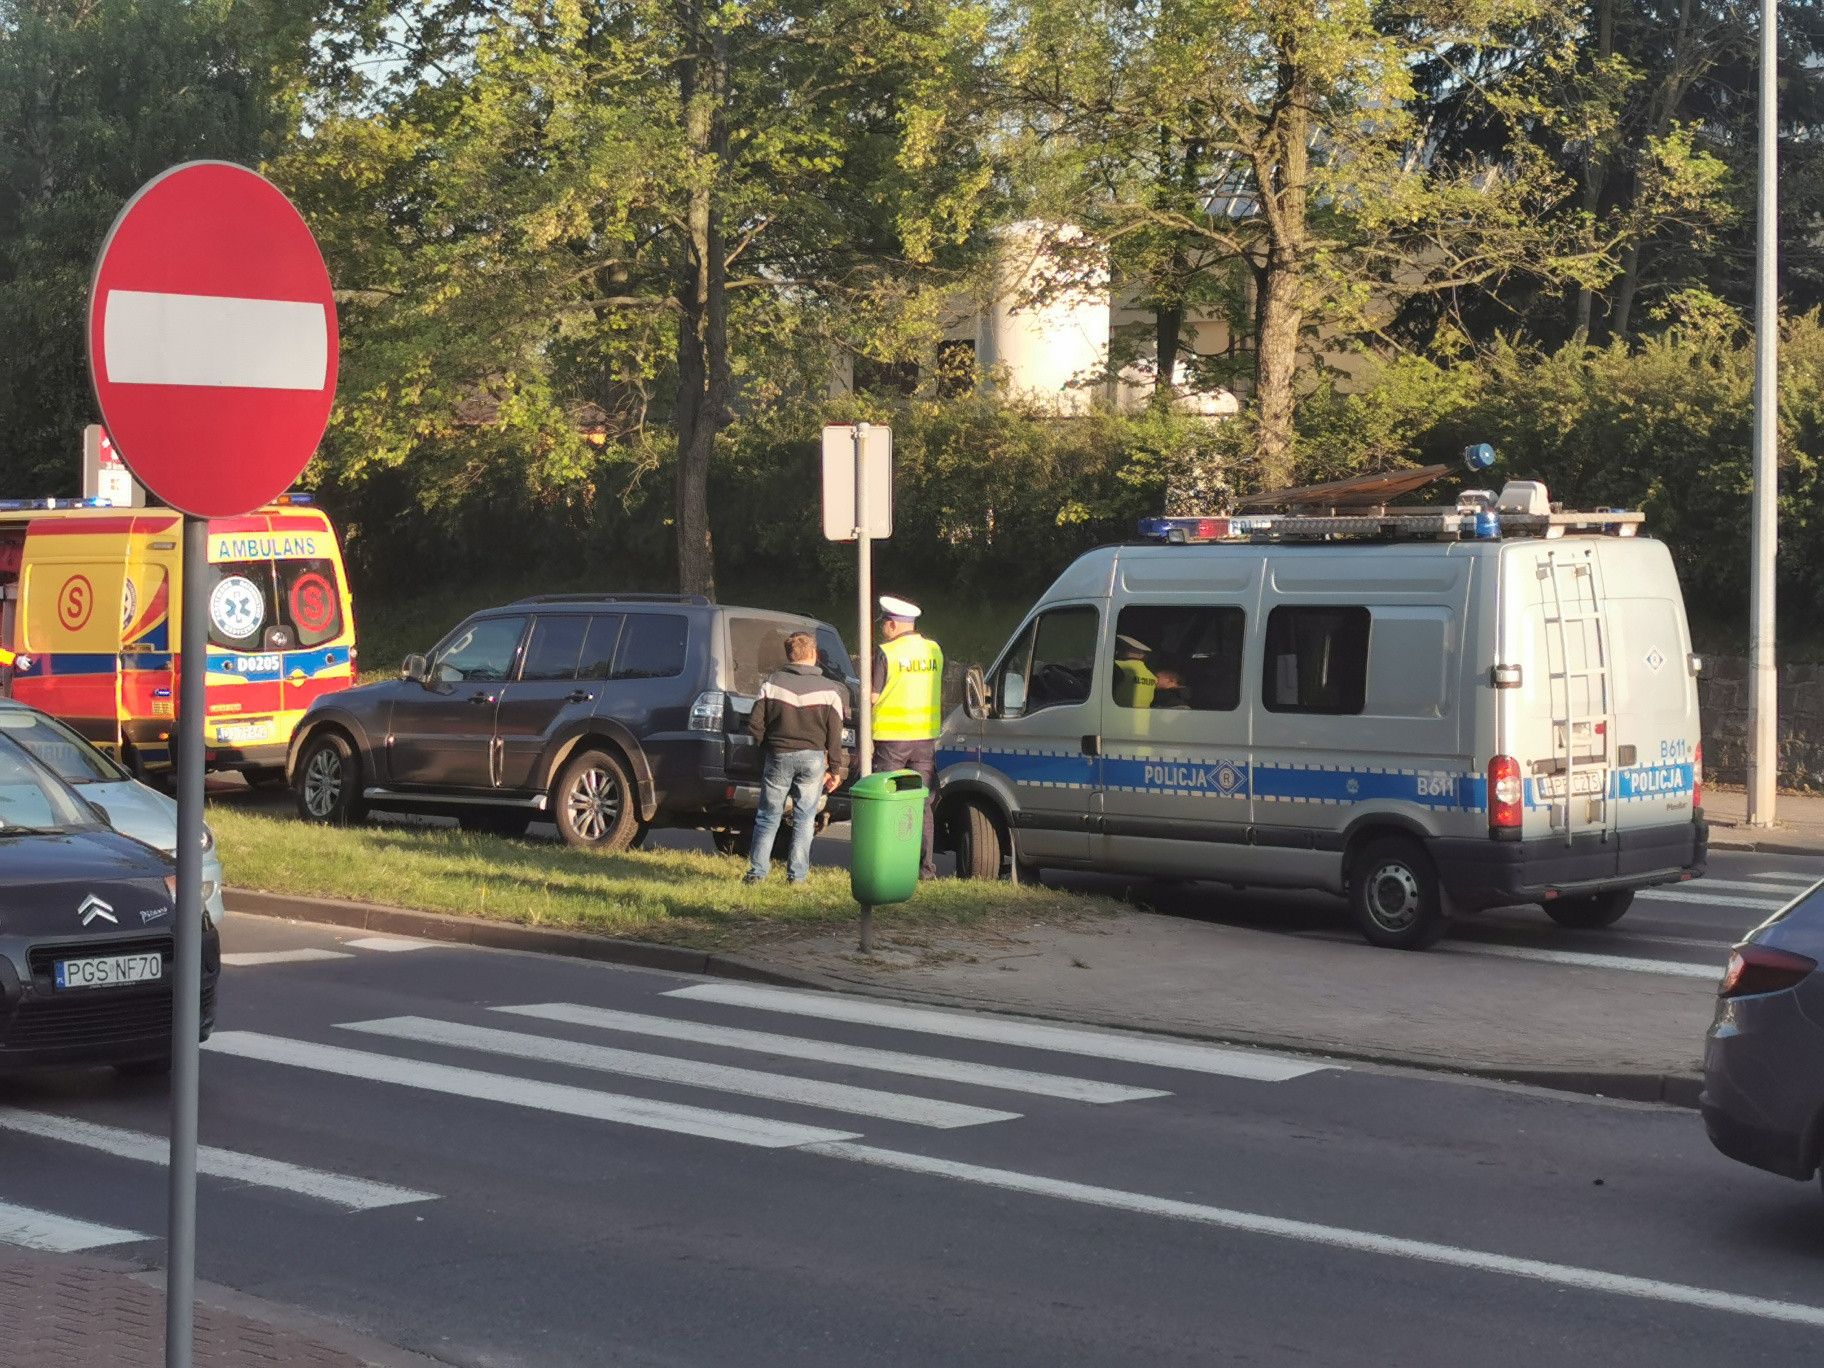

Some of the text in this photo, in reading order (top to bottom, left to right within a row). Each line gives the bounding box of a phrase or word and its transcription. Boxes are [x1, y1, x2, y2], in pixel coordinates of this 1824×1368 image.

[219, 538, 316, 558] AMBULANS
[67, 587, 83, 618] S
[302, 586, 324, 620] S
[899, 658, 938, 672] POLICJA
[1660, 739, 1685, 758] B611
[1144, 765, 1208, 788] POLICJA
[1417, 777, 1454, 797] B611
[1631, 767, 1683, 793] POLICJA
[67, 955, 160, 984] PGS NF70
